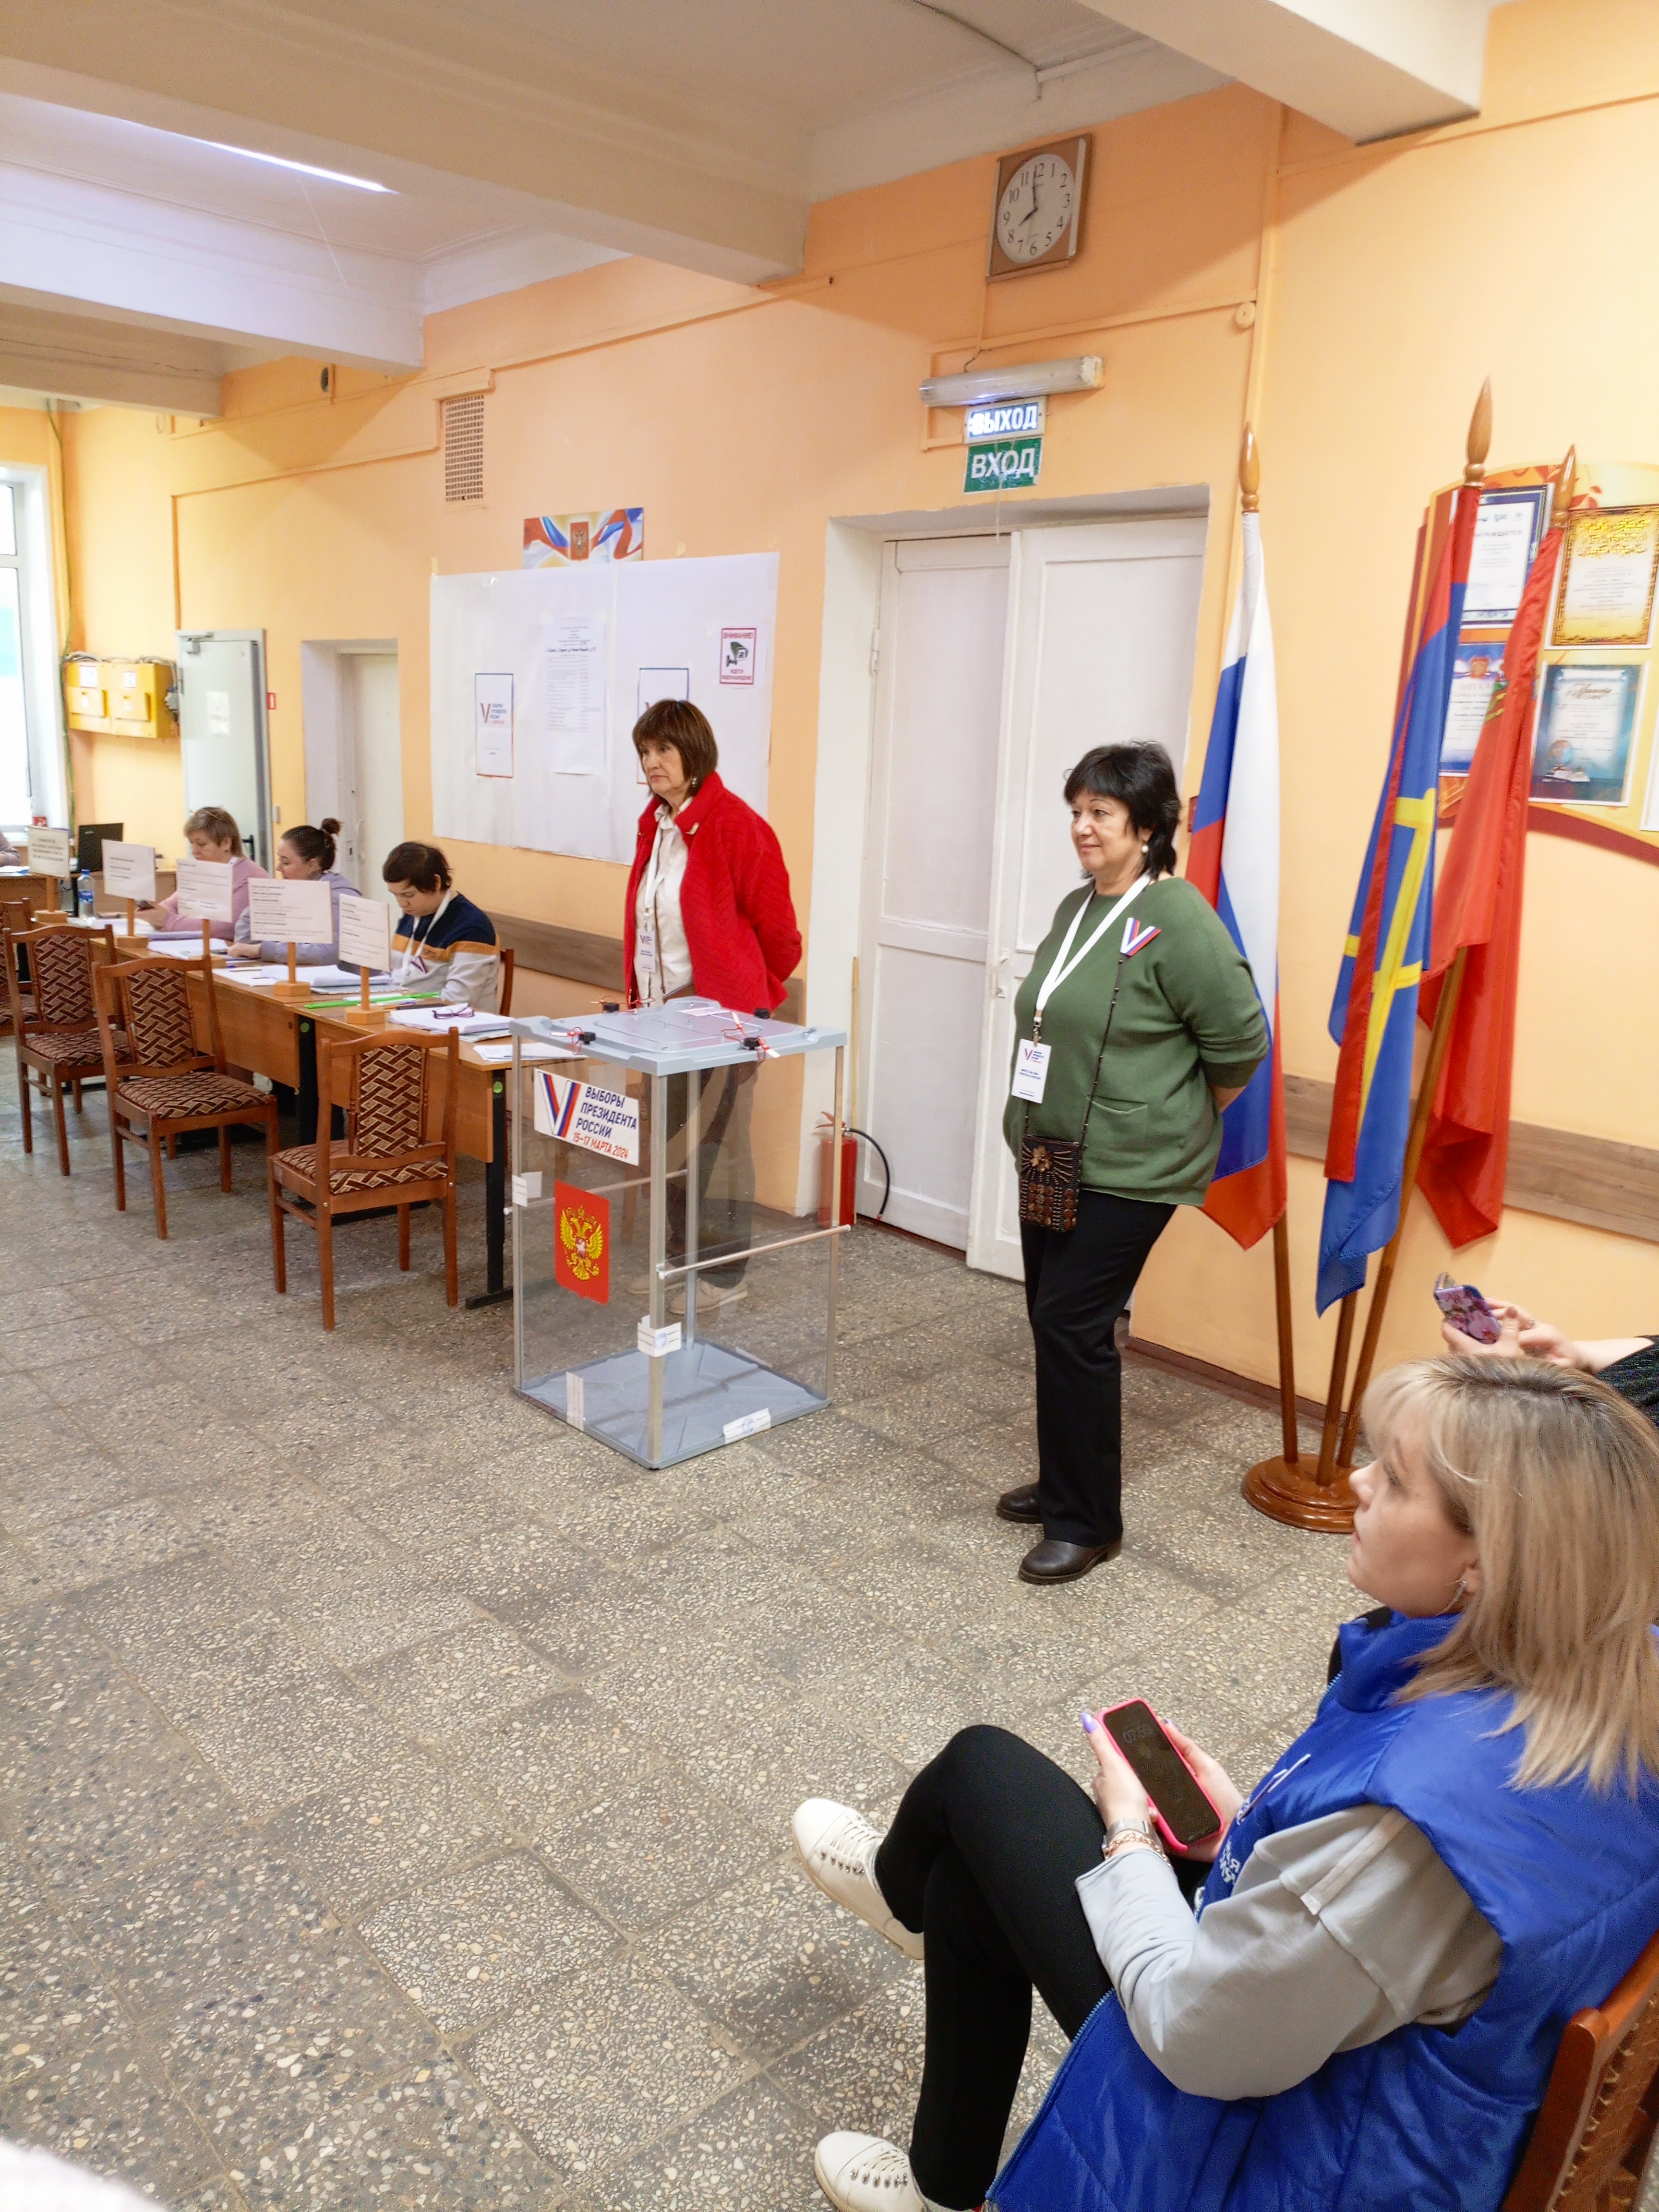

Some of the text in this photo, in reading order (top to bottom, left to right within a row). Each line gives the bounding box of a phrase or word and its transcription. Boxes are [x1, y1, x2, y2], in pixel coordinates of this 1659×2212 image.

[1034, 163, 1044, 178] 12
[1051, 163, 1056, 177] 1
[1021, 171, 1029, 186] 11
[1060, 173, 1067, 188] 2
[1009, 188, 1019, 204] 10
[1062, 193, 1070, 208] 3
[1003, 211, 1010, 226] 9
[1057, 216, 1063, 229] 4
[1008, 229, 1014, 243] 8
[1045, 232, 1052, 247] 5
[1018, 240, 1023, 253] 7
[1030, 241, 1037, 255] 6
[970, 406, 1037, 435] ВЫХОД
[971, 448, 1035, 479] ВХОД
[585, 1086, 625, 1108] ВЫБОРЫ
[580, 1103, 637, 1130] ПРЕЗИДЕНТА
[576, 1118, 612, 1138] РОССИИ
[590, 1138, 612, 1154] МАРТА
[611, 1145, 629, 1159] 2024
